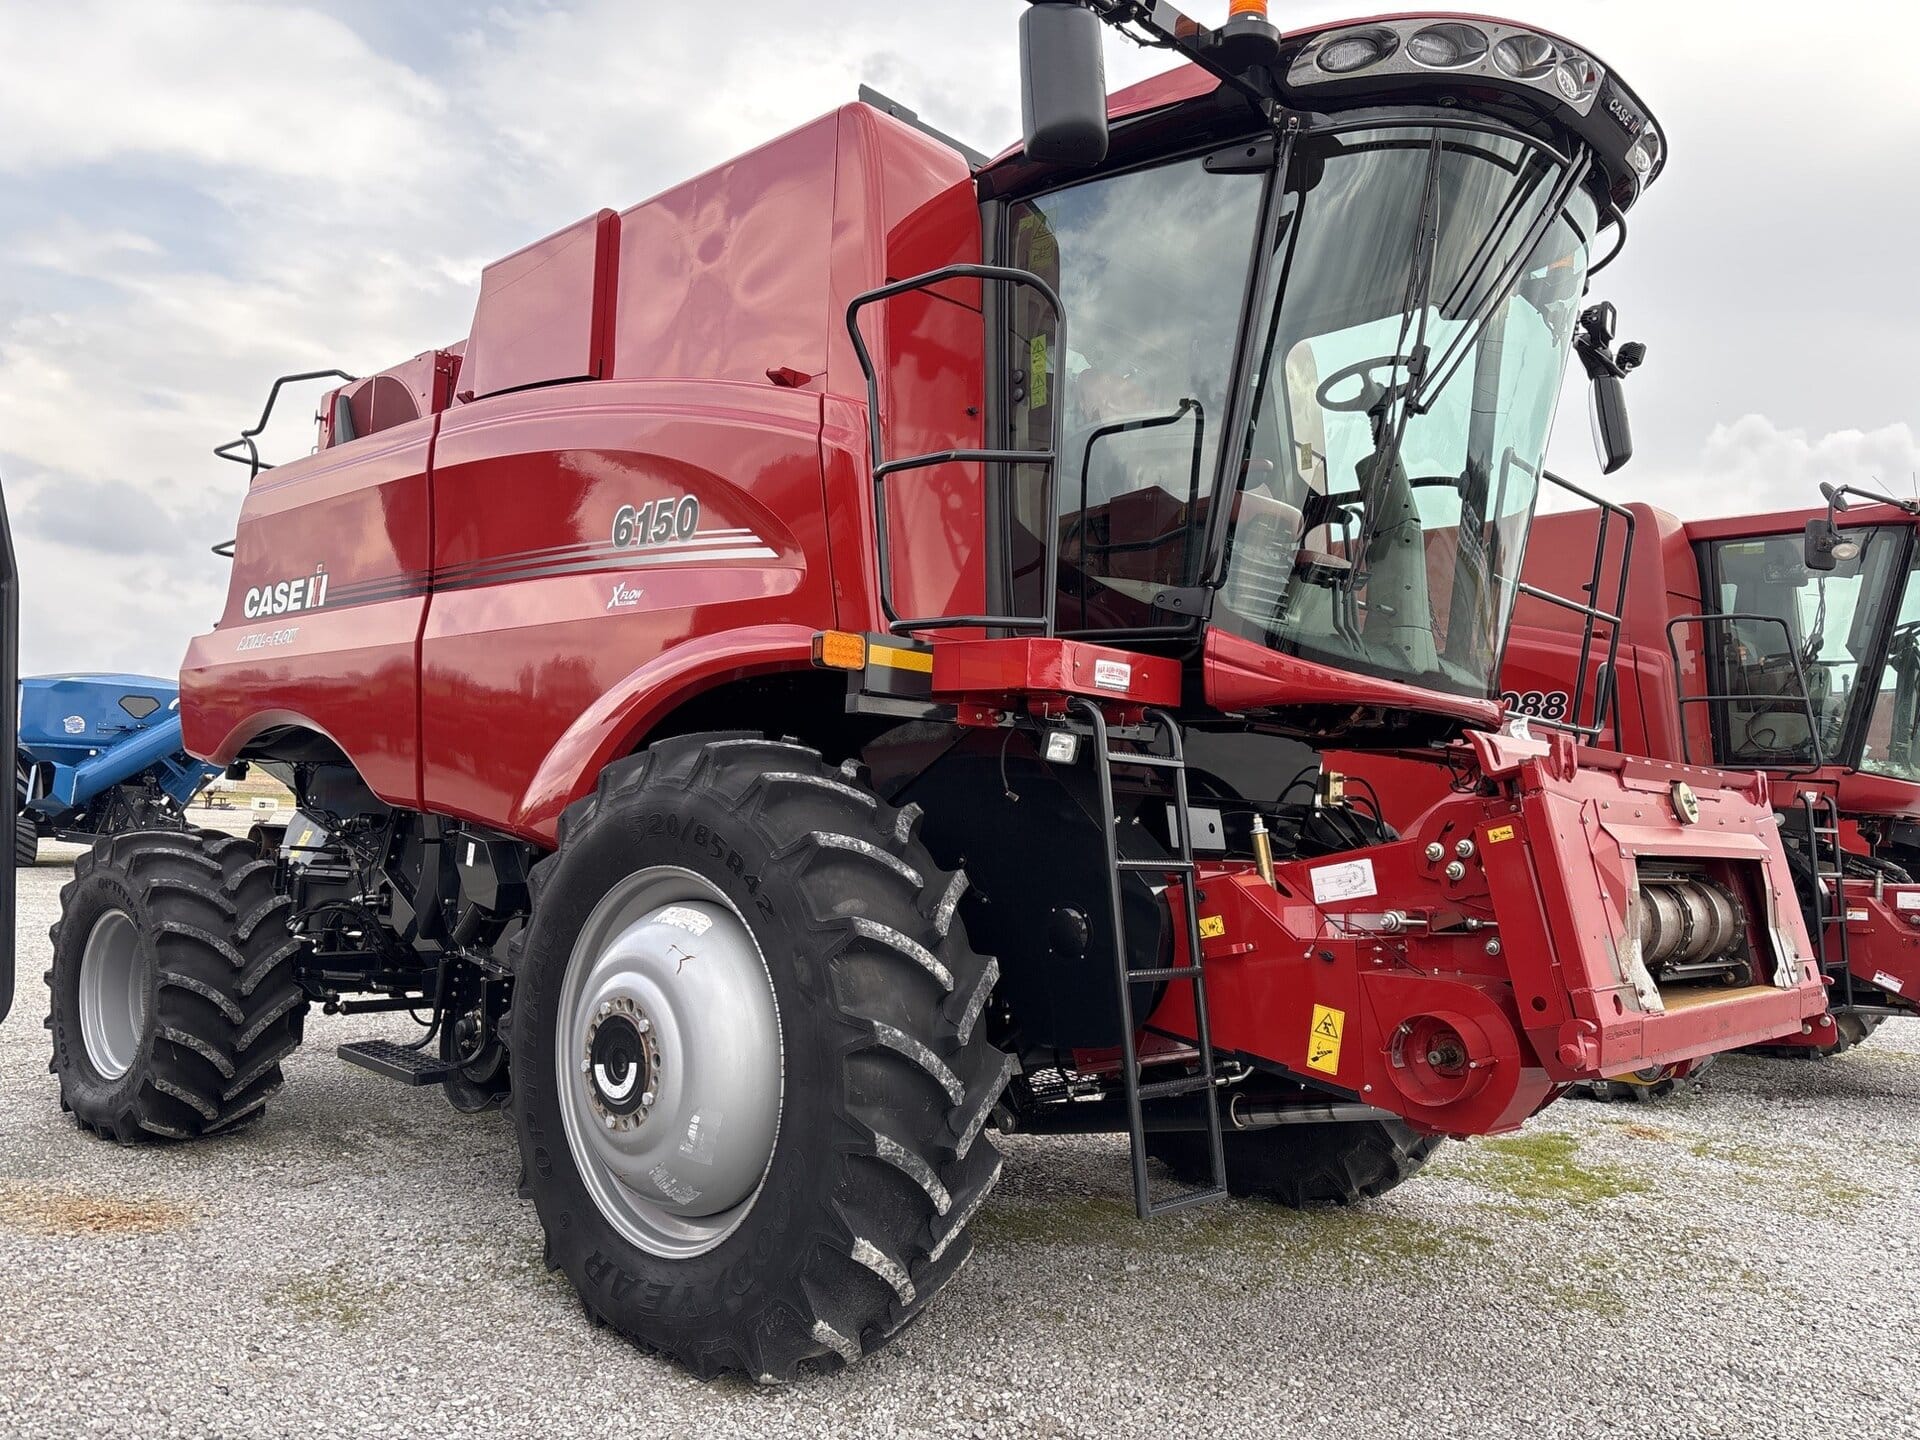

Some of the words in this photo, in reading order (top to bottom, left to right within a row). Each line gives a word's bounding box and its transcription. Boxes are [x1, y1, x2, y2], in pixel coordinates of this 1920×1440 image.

[1609, 98, 1632, 126] CASE
[612, 494, 700, 549] 6150
[244, 578, 305, 619] CASE
